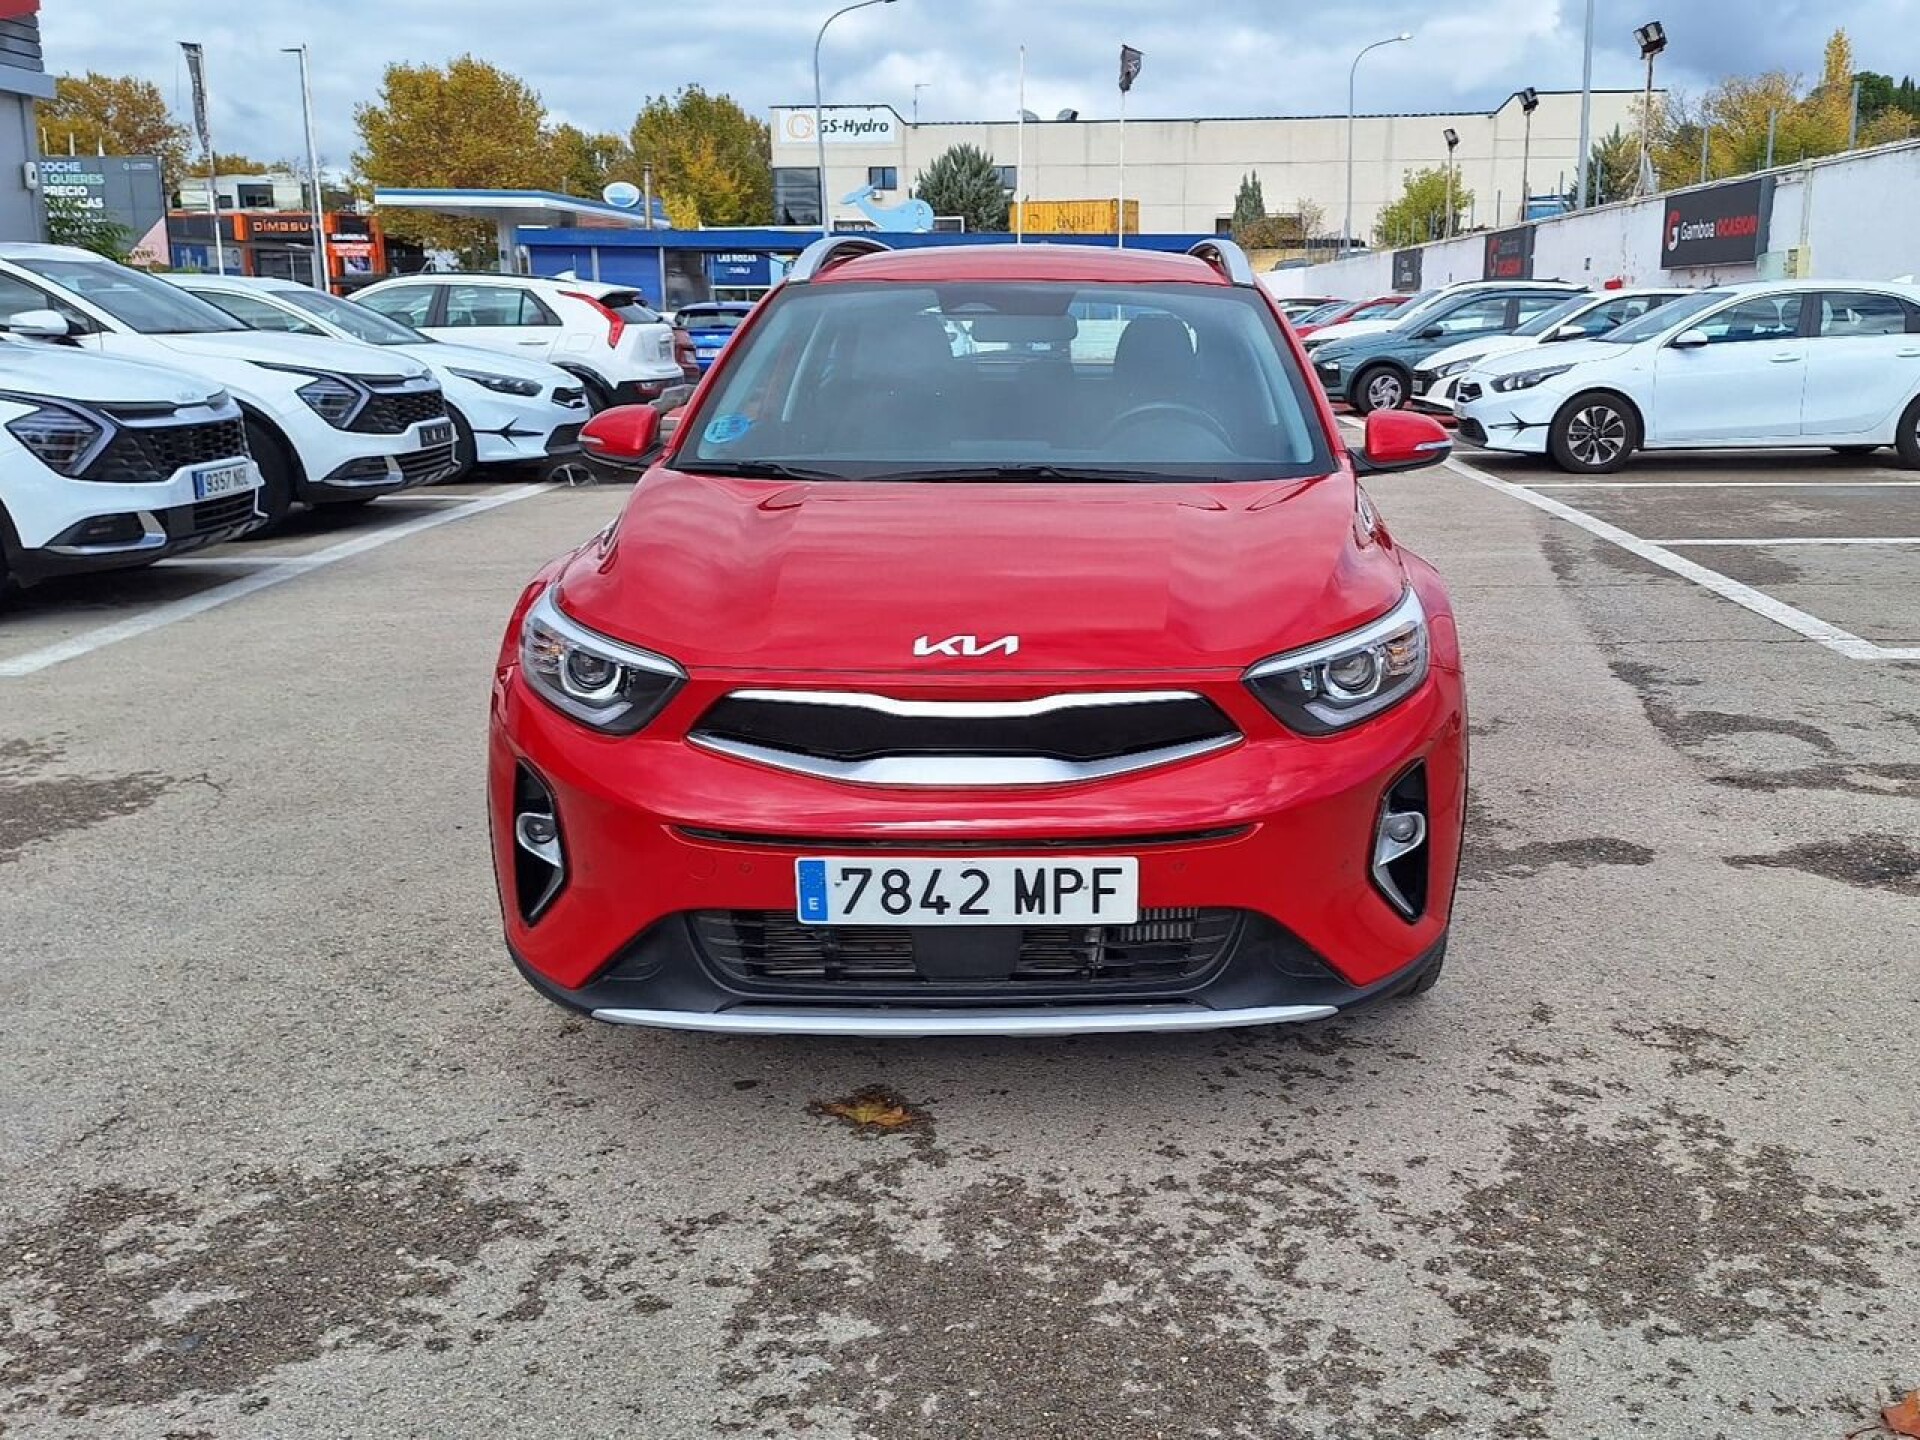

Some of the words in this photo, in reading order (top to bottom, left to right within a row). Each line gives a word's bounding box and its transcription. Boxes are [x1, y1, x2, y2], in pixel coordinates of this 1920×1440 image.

[50, 173, 105, 184] QUIERES
[43, 185, 88, 196] PRECIO
[1681, 219, 1715, 240] Gamboa
[913, 635, 1019, 656] KIA
[841, 868, 991, 915] 7842
[1014, 868, 1123, 915] MPF
[809, 899, 819, 911] E
